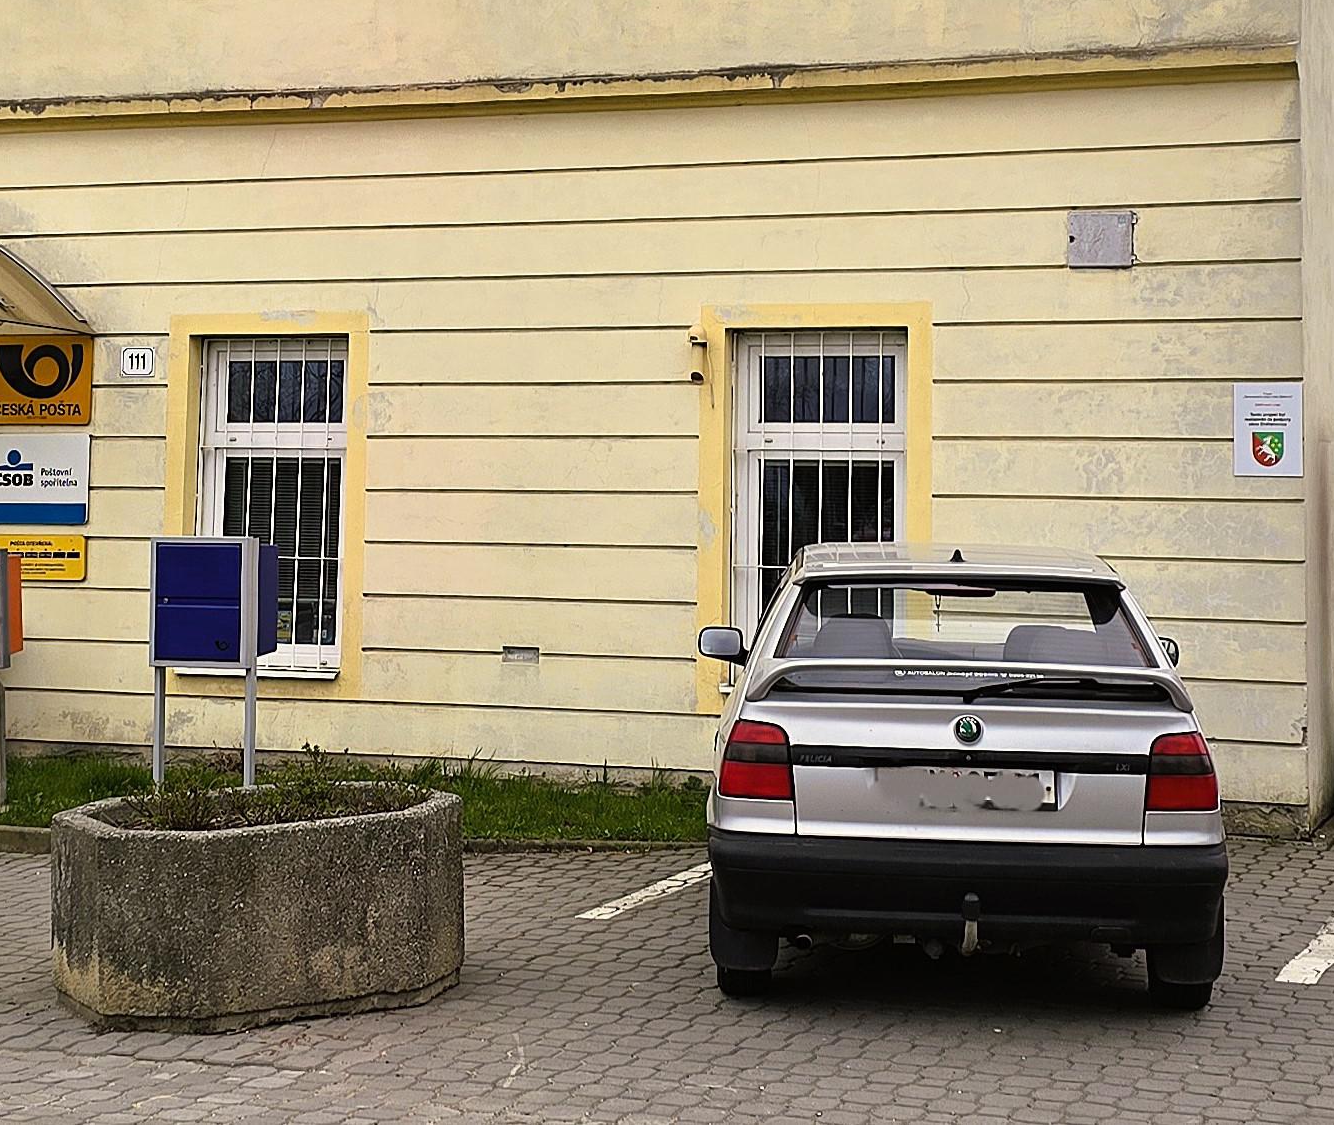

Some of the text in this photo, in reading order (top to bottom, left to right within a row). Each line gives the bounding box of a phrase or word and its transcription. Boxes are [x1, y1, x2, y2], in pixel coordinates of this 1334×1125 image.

[128, 352, 146, 370] 111
[39, 400, 82, 416] POŠTA
[40, 467, 73, 476] Poštovní
